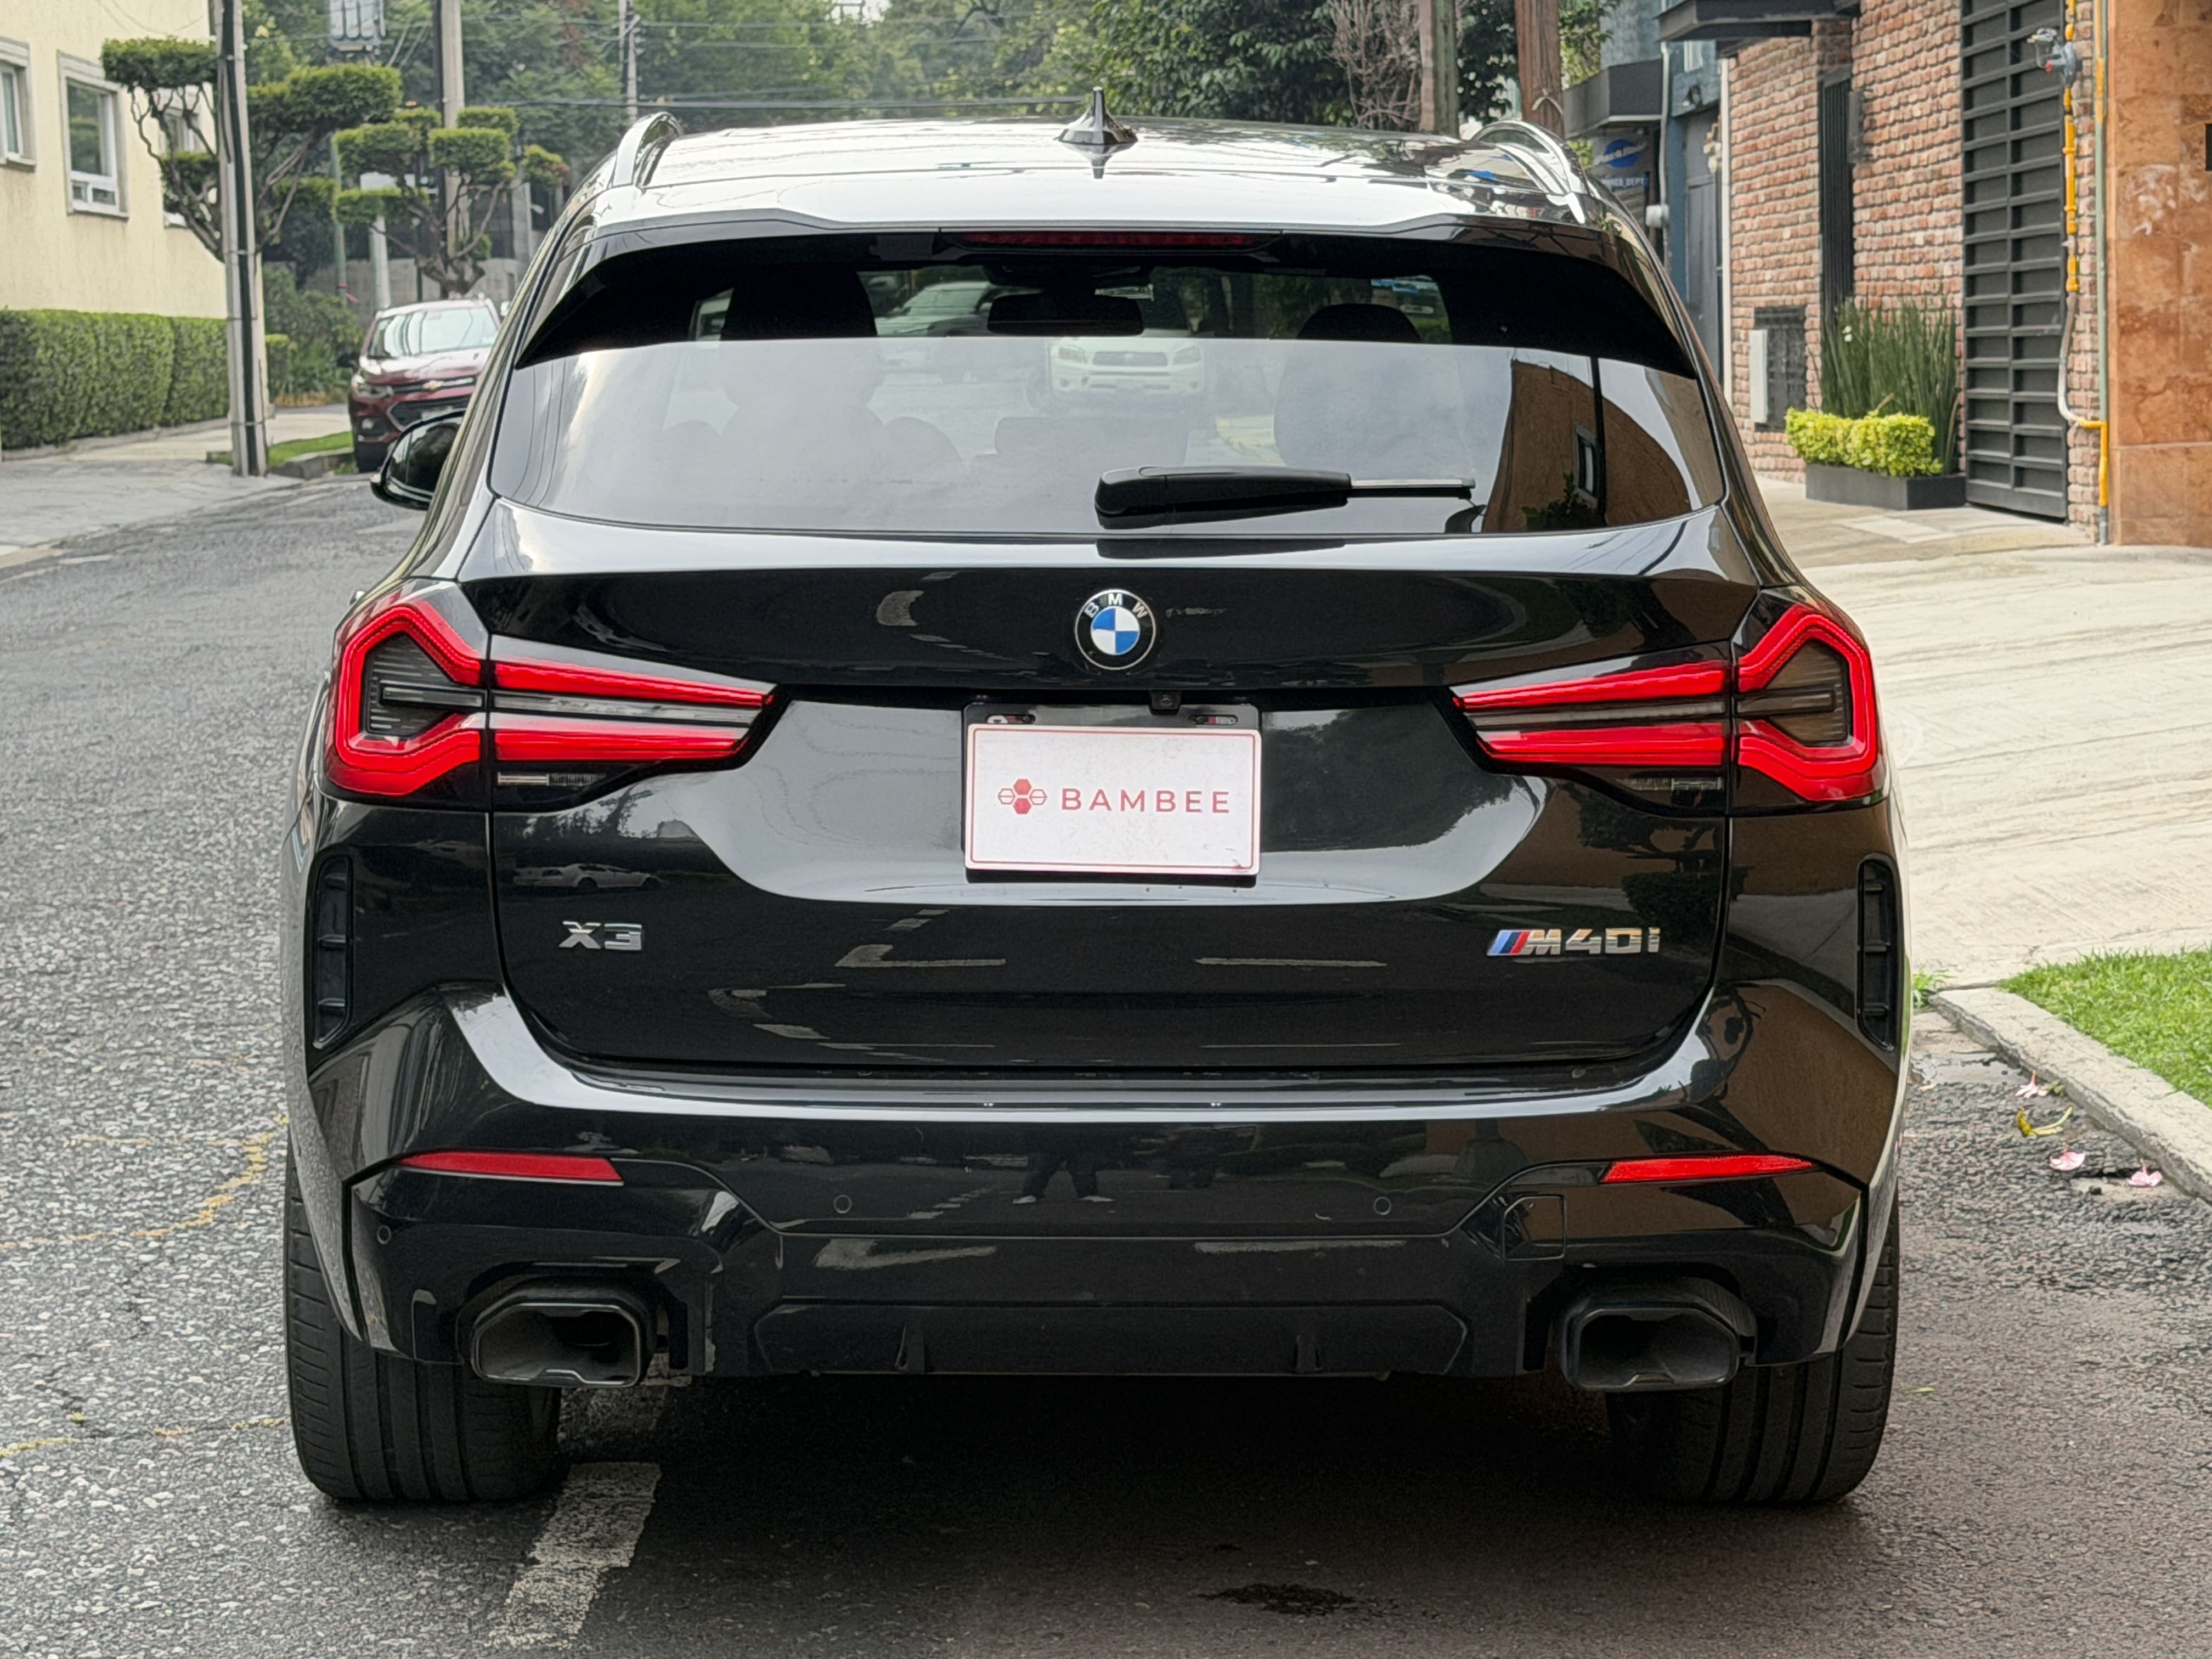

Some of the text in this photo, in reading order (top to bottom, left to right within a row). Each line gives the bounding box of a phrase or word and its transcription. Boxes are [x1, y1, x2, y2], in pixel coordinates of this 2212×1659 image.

[1084, 593, 1148, 619] BMW
[1060, 788, 1230, 814] BAMBEE
[558, 921, 642, 951] X3
[1517, 927, 1661, 955] M40i
